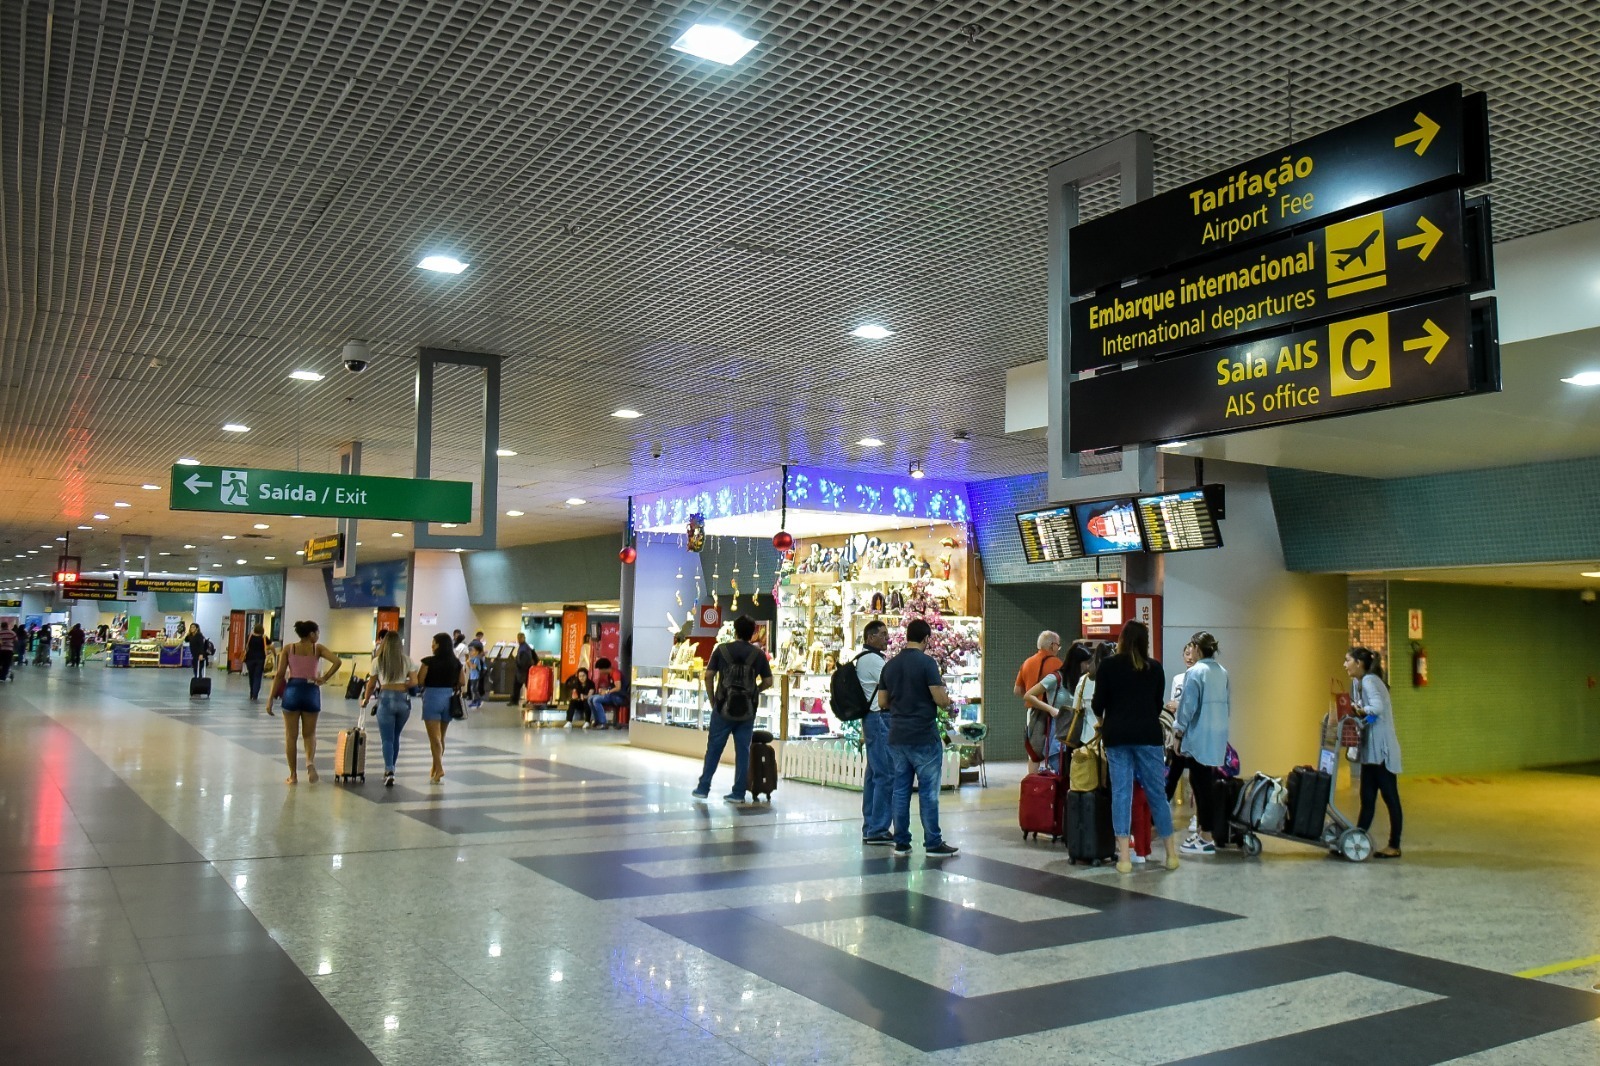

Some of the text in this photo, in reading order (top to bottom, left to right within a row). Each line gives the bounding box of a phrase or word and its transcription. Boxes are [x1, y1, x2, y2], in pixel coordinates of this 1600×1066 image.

[1189, 155, 1314, 216] Tarifação
[1201, 192, 1315, 245] Airport Fee
[1089, 241, 1315, 330] Embarque internacional
[1102, 288, 1316, 357] International departures
[1216, 339, 1319, 386] Sala AIS
[1341, 328, 1377, 381] C
[1225, 383, 1320, 419] AIS office
[259, 483, 368, 505] Saída / Exit
[135, 579, 165, 587] Embarque
[568, 623, 577, 665] EXPRESSA
